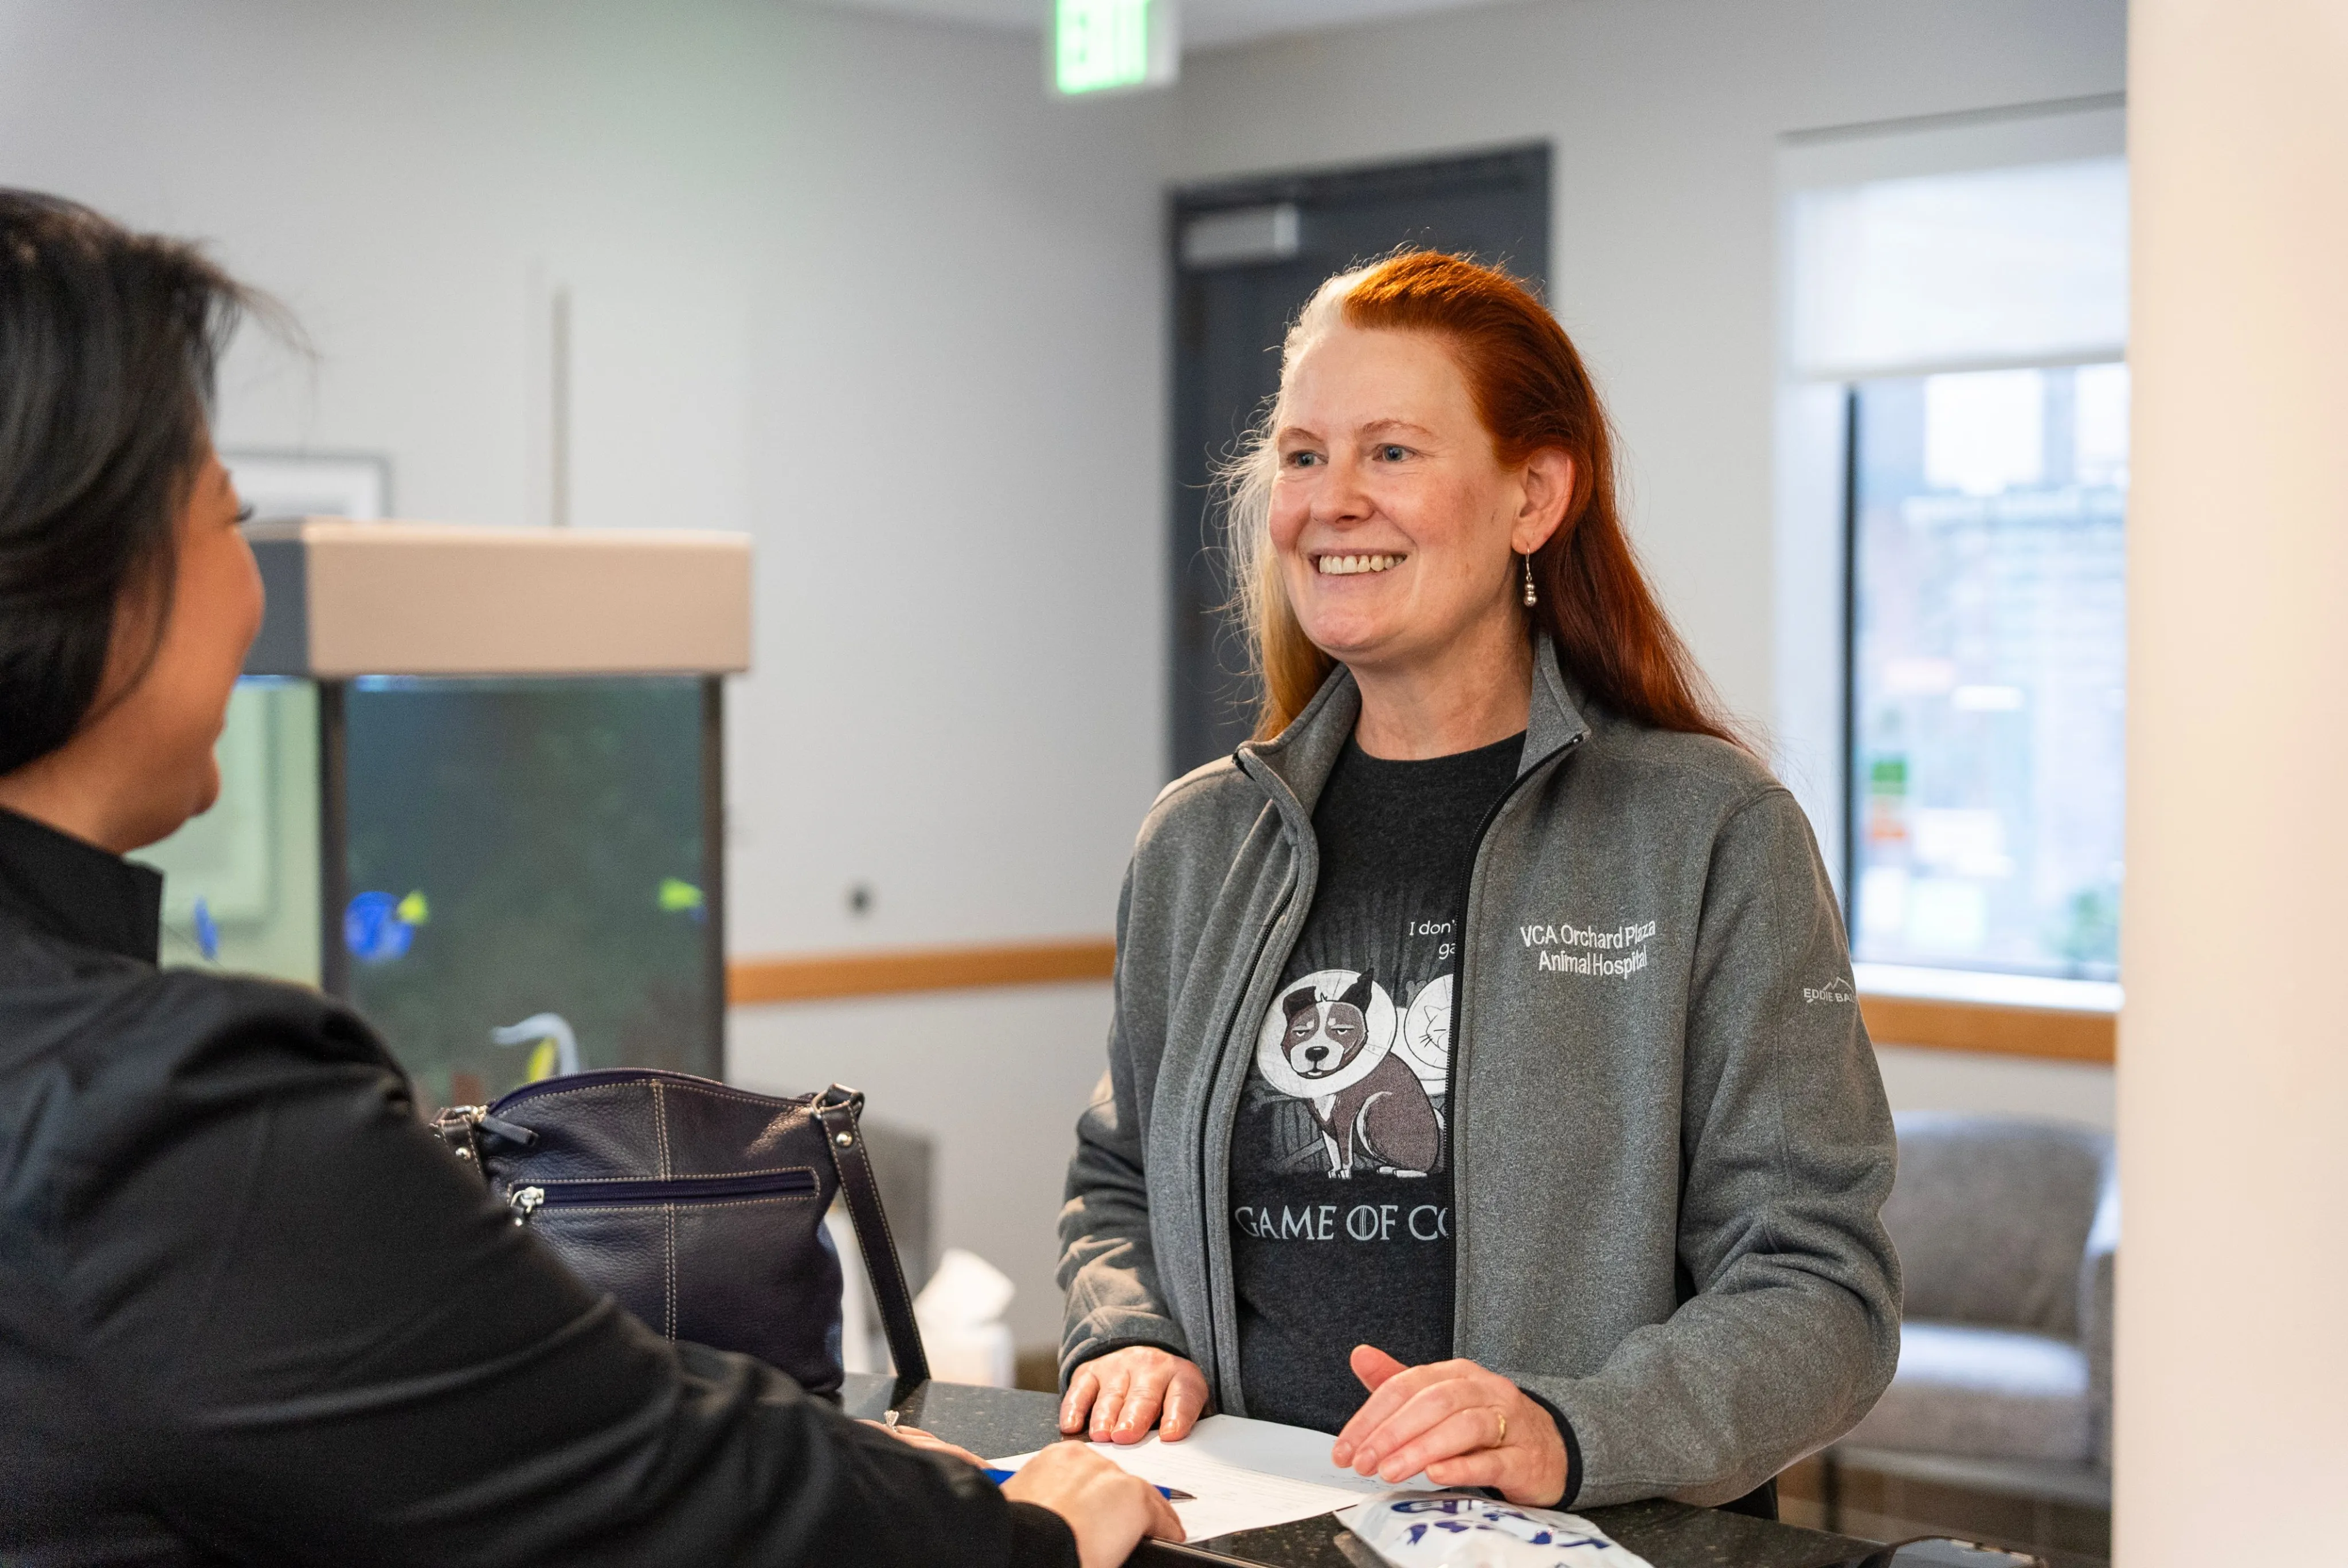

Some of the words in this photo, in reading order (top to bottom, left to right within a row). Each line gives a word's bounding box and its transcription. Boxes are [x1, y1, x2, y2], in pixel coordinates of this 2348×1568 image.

[1409, 922, 1415, 936] I
[1419, 920, 1457, 935] don'
[1520, 925, 1558, 947] VCA
[1561, 924, 1623, 949] Orchard
[1625, 920, 1656, 947] Plaza
[1539, 950, 1590, 975] Animal
[1593, 944, 1647, 979] Hospital
[1803, 988, 1833, 1002] EDDIE
[1235, 1205, 1337, 1240] GAME
[1346, 1205, 1398, 1241] OF
